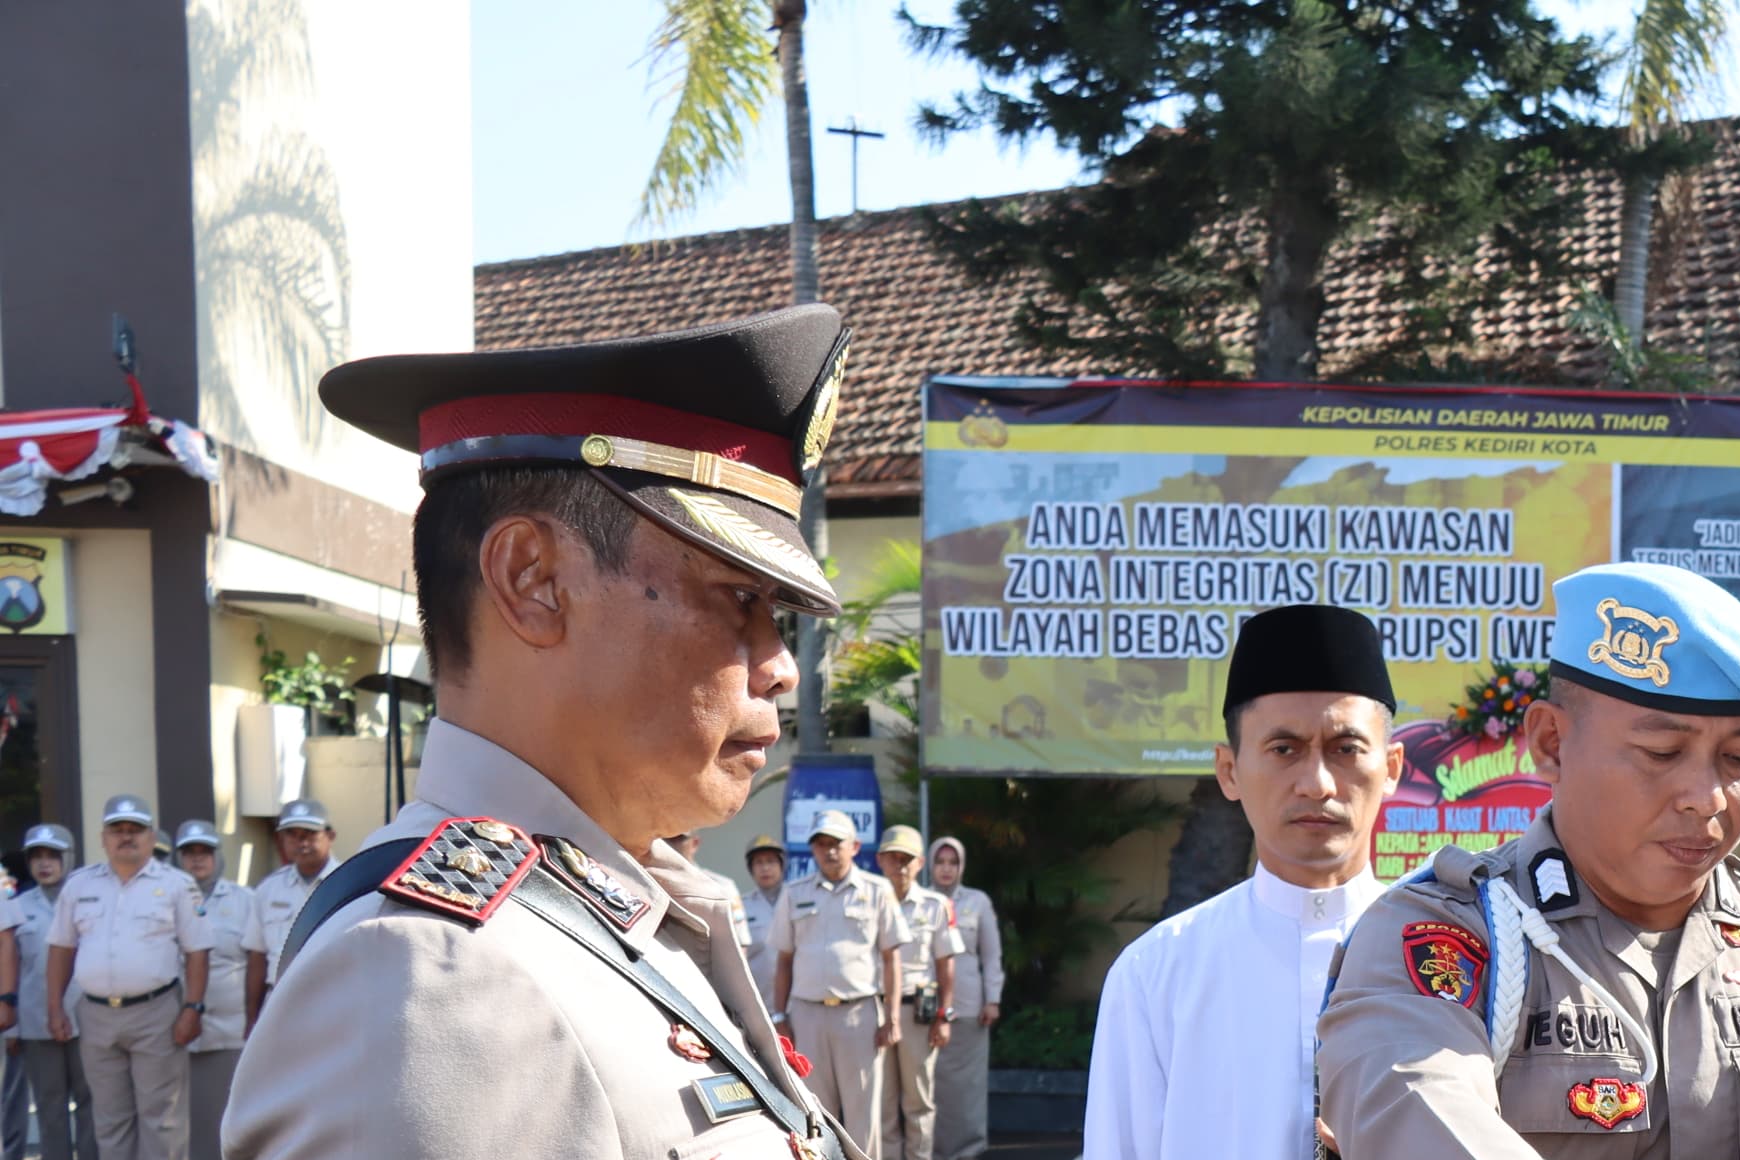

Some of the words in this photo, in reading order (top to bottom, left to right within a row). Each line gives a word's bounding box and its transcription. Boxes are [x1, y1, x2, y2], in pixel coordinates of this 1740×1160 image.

[1302, 406, 1432, 425] KEPOLISIAN
[1437, 409, 1529, 427] DAERAH
[1532, 412, 1595, 430] JAWA
[1601, 413, 1670, 432] TIMUR
[1374, 435, 1457, 452] POLRES
[1464, 437, 1535, 454] KEDIRI
[1541, 439, 1597, 456] KOTA
[1029, 504, 1126, 547] ANDA
[1137, 506, 1327, 550] MEMASUKI
[1339, 509, 1511, 553] KAWASAN
[1007, 557, 1102, 600] ZONA
[1113, 559, 1315, 602] INTEGRITAS
[1328, 560, 1388, 605] (ZI)
[1402, 563, 1541, 607] MENUJU
[945, 609, 1100, 653] WILAYAH
[1113, 612, 1226, 655] BEBAS
[1381, 617, 1477, 658] RUPSI
